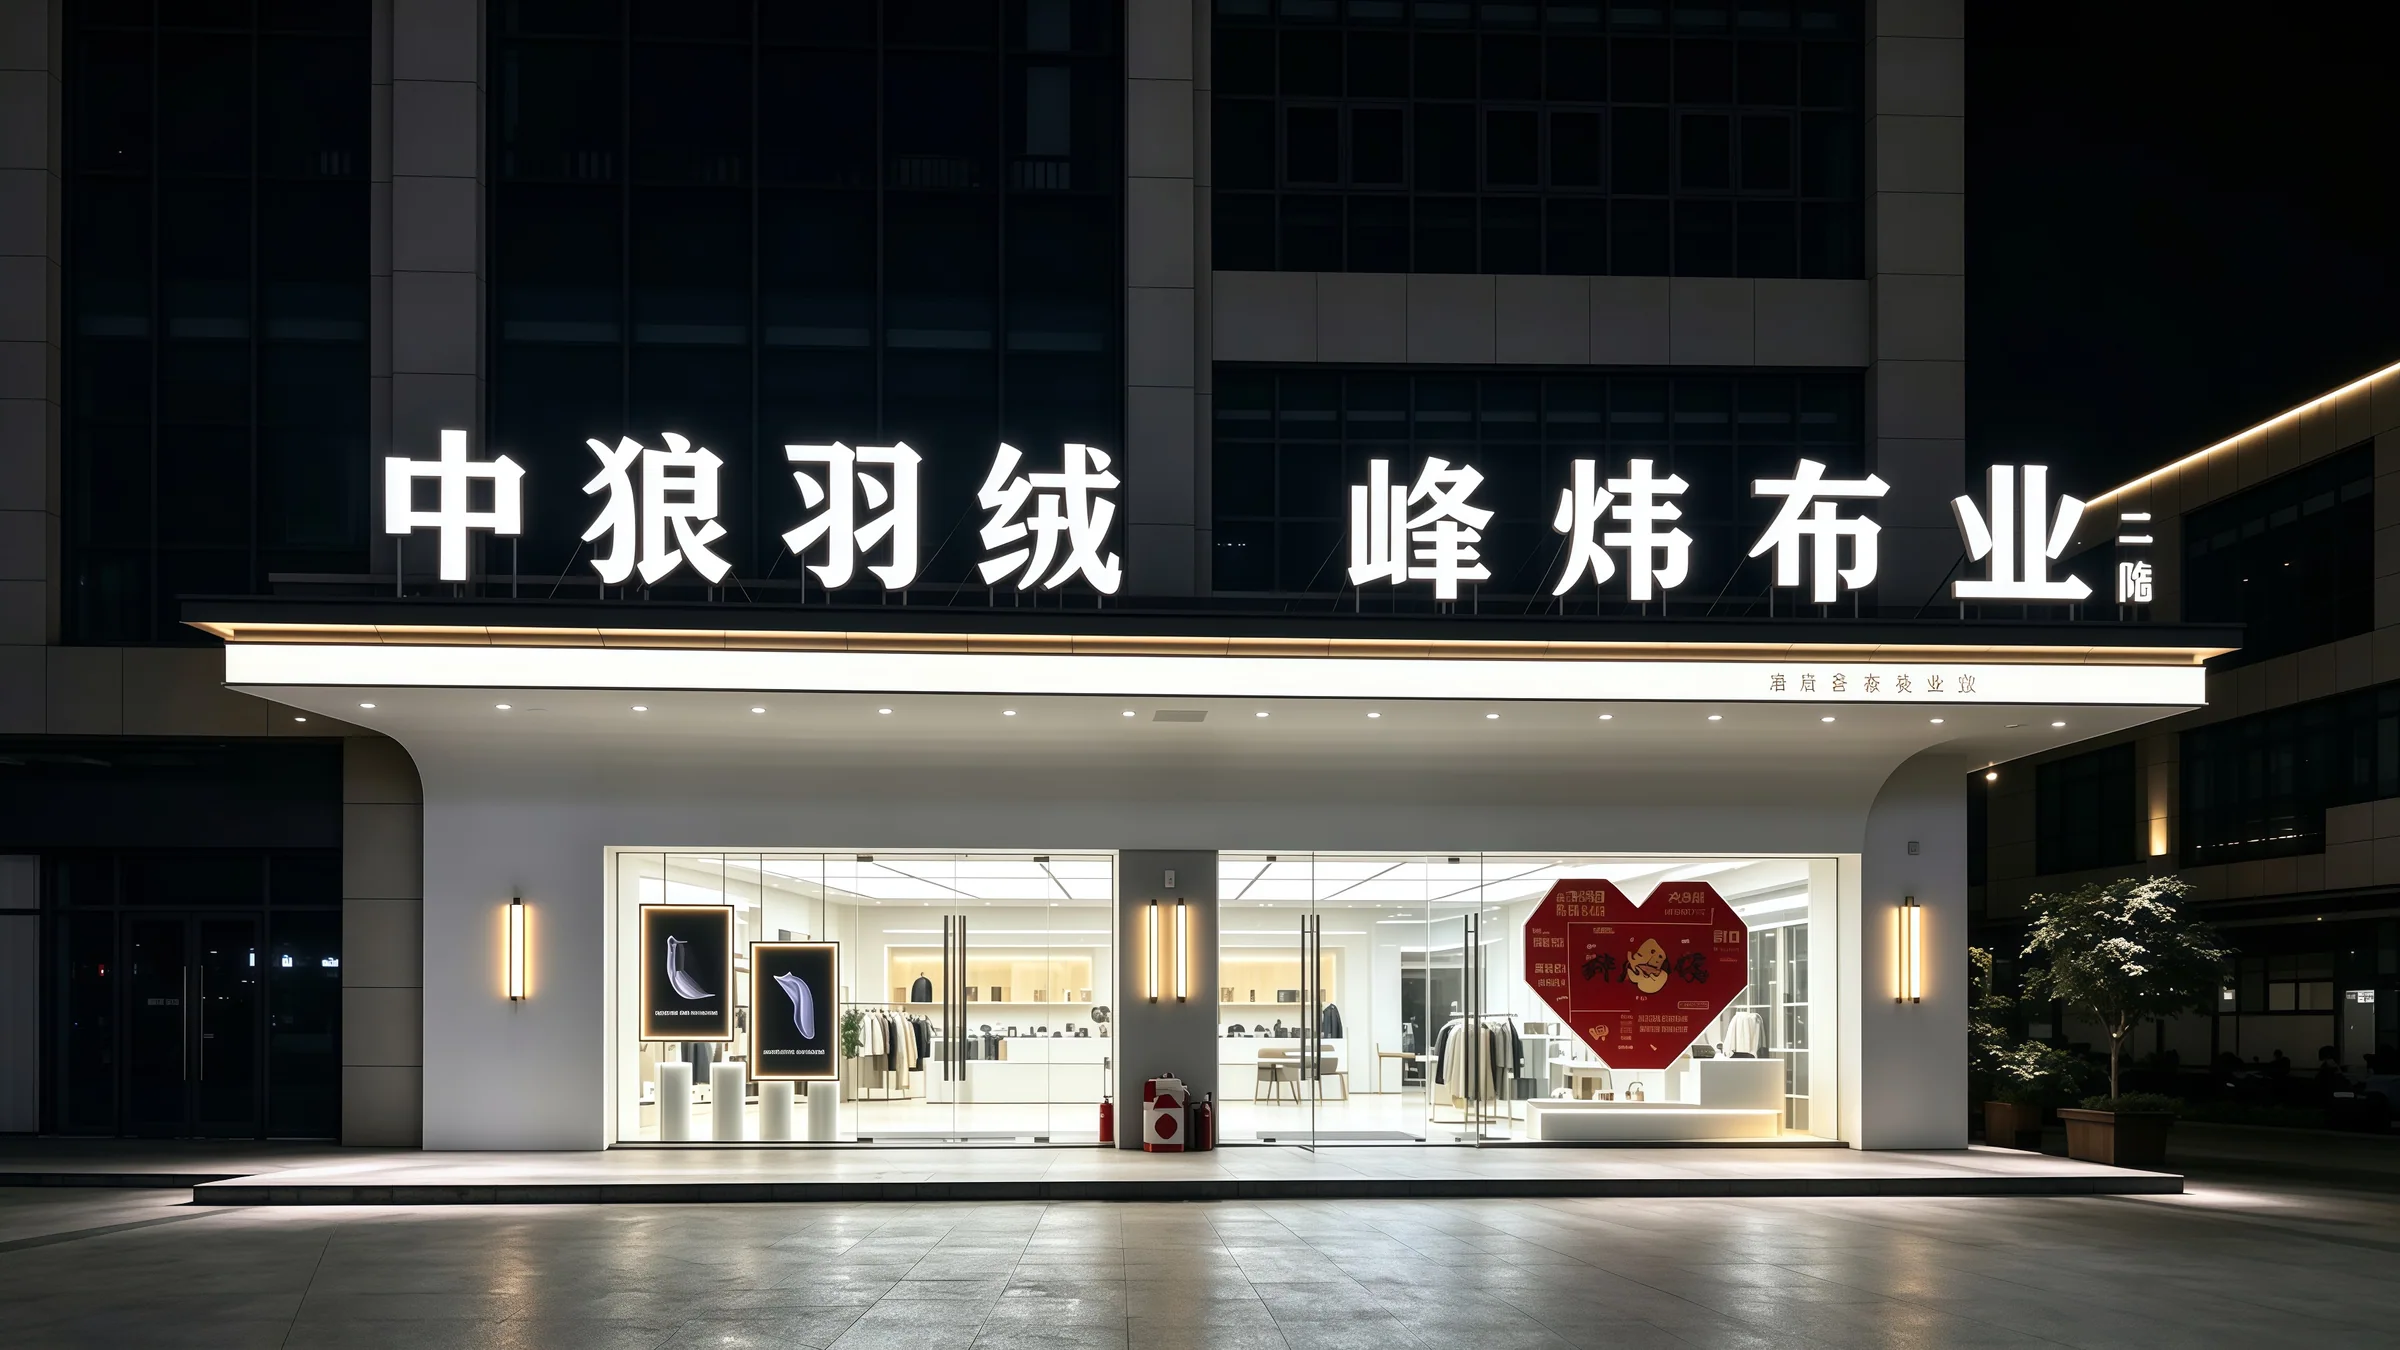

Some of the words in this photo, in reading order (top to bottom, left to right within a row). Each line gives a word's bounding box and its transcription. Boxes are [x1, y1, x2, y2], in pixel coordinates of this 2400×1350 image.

[384, 429, 1124, 595] 中狼羽绒
[1347, 456, 2092, 603] 峰炜布业
